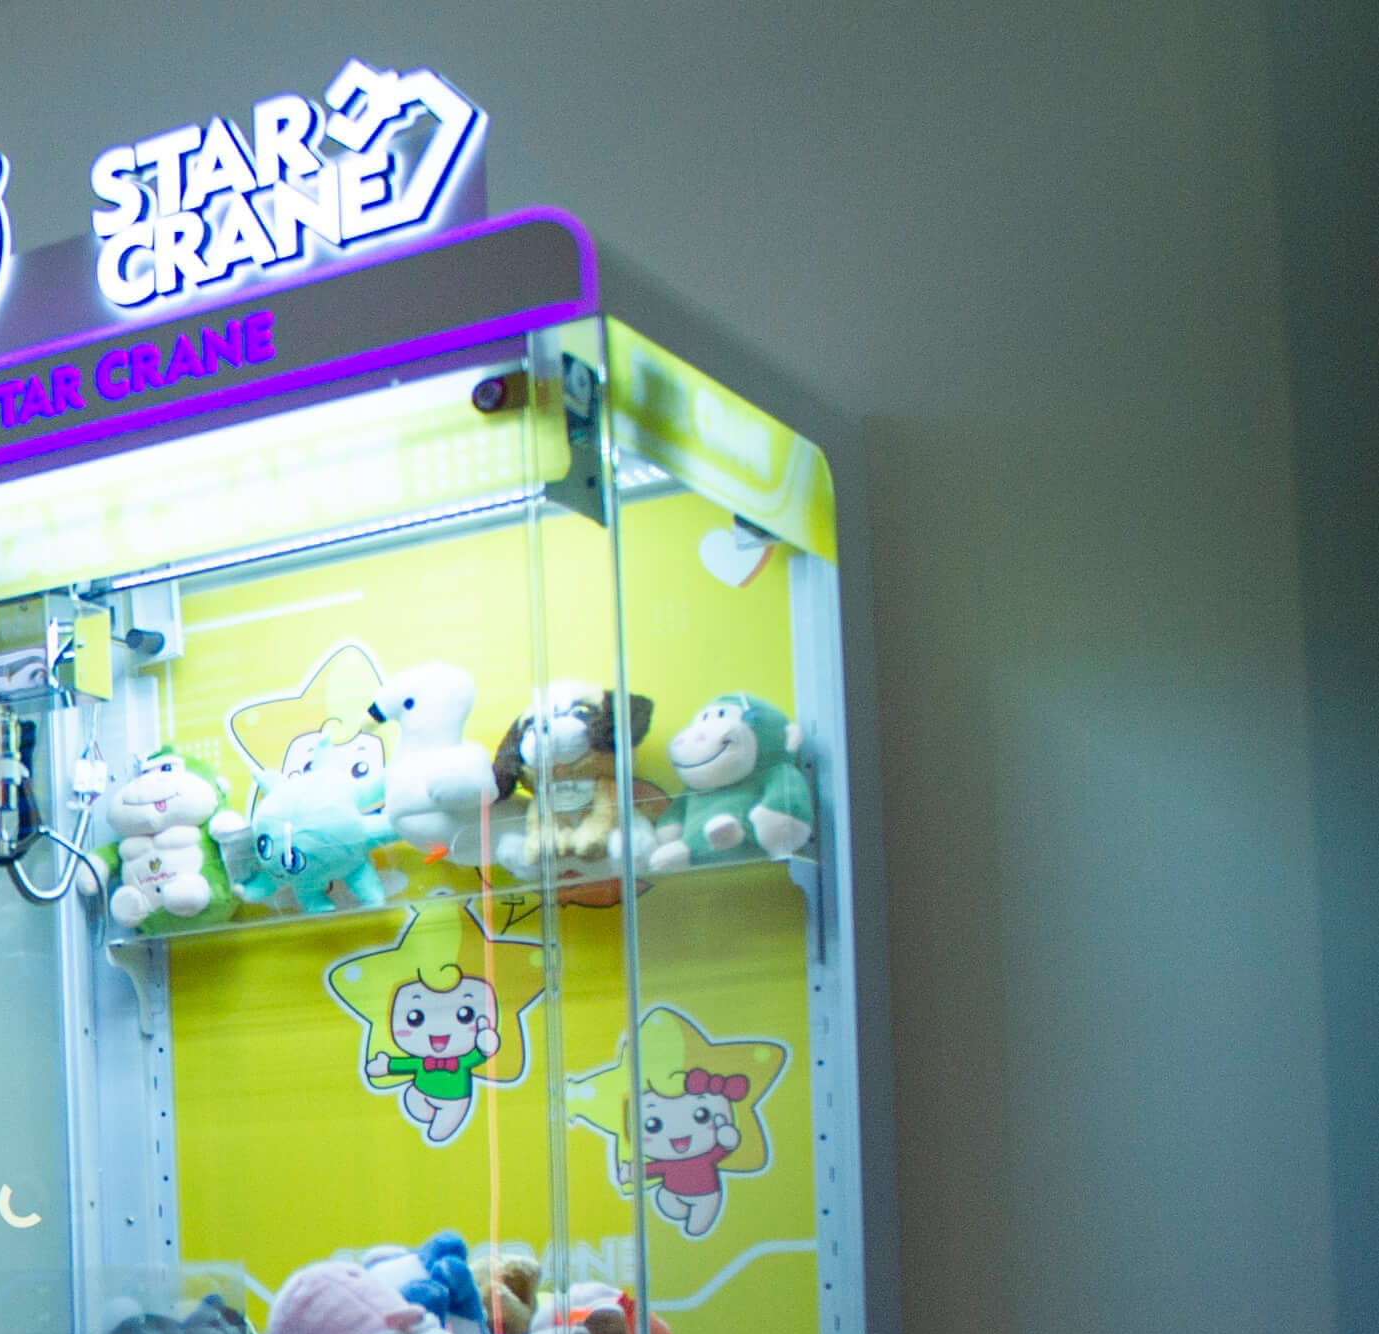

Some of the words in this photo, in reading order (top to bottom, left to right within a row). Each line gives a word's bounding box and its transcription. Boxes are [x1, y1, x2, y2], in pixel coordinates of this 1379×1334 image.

[90, 94, 324, 238] STAR
[96, 150, 396, 309] CRANE
[94, 309, 275, 401] CRANE
